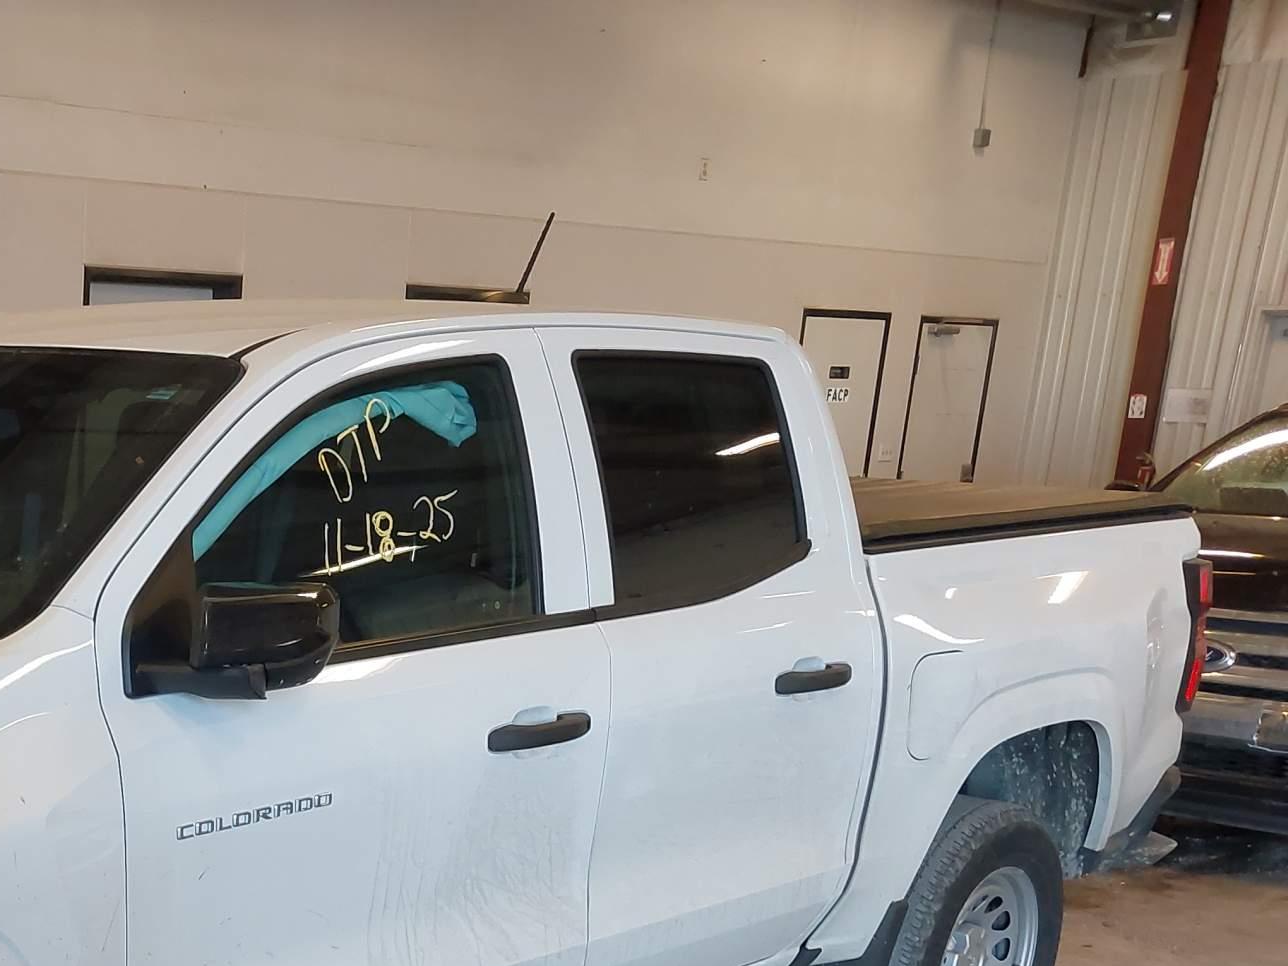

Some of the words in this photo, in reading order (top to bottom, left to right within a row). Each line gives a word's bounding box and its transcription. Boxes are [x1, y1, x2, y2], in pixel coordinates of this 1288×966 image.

[826, 388, 849, 402] FACP
[318, 398, 391, 504] DTP
[323, 489, 459, 577] 11-18-25
[176, 792, 333, 841] COLORADO
